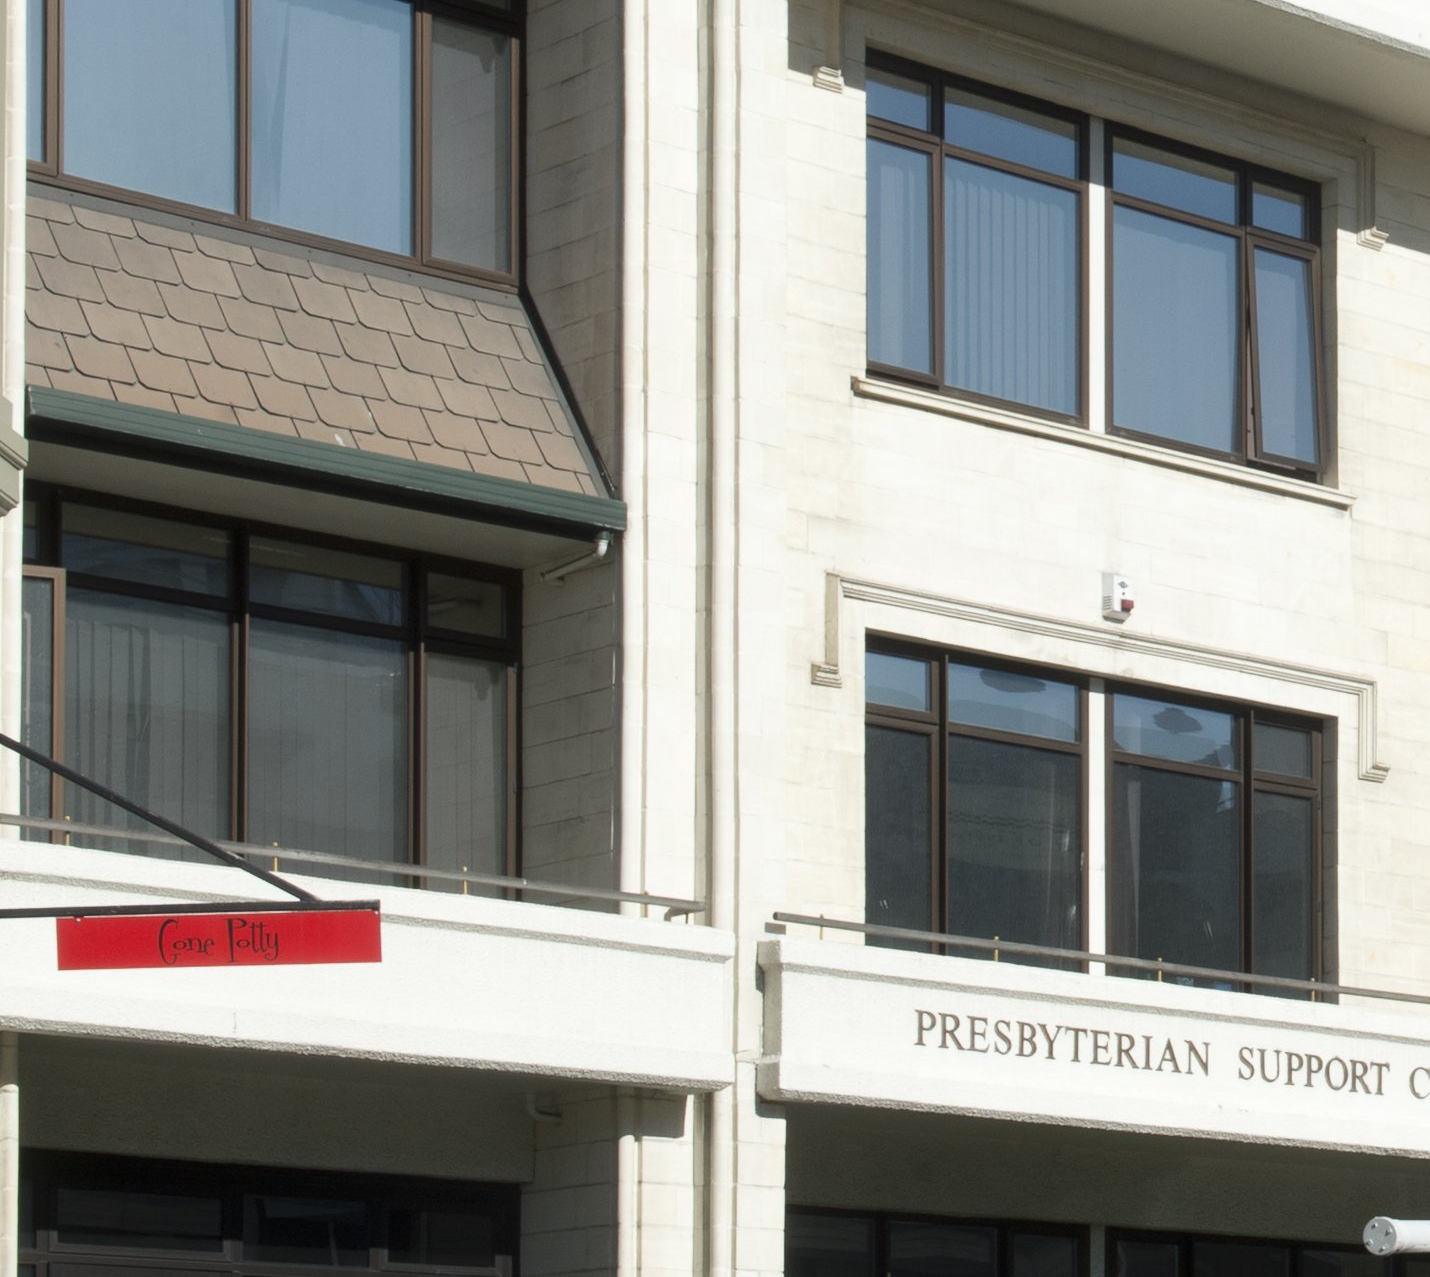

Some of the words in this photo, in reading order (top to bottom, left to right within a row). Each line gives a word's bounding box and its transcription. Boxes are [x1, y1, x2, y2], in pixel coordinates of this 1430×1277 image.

[224, 917, 279, 963] Potty
[914, 1009, 1211, 1076] PRESBYTERIAN
[1238, 1046, 1391, 1096] SUPPORT
